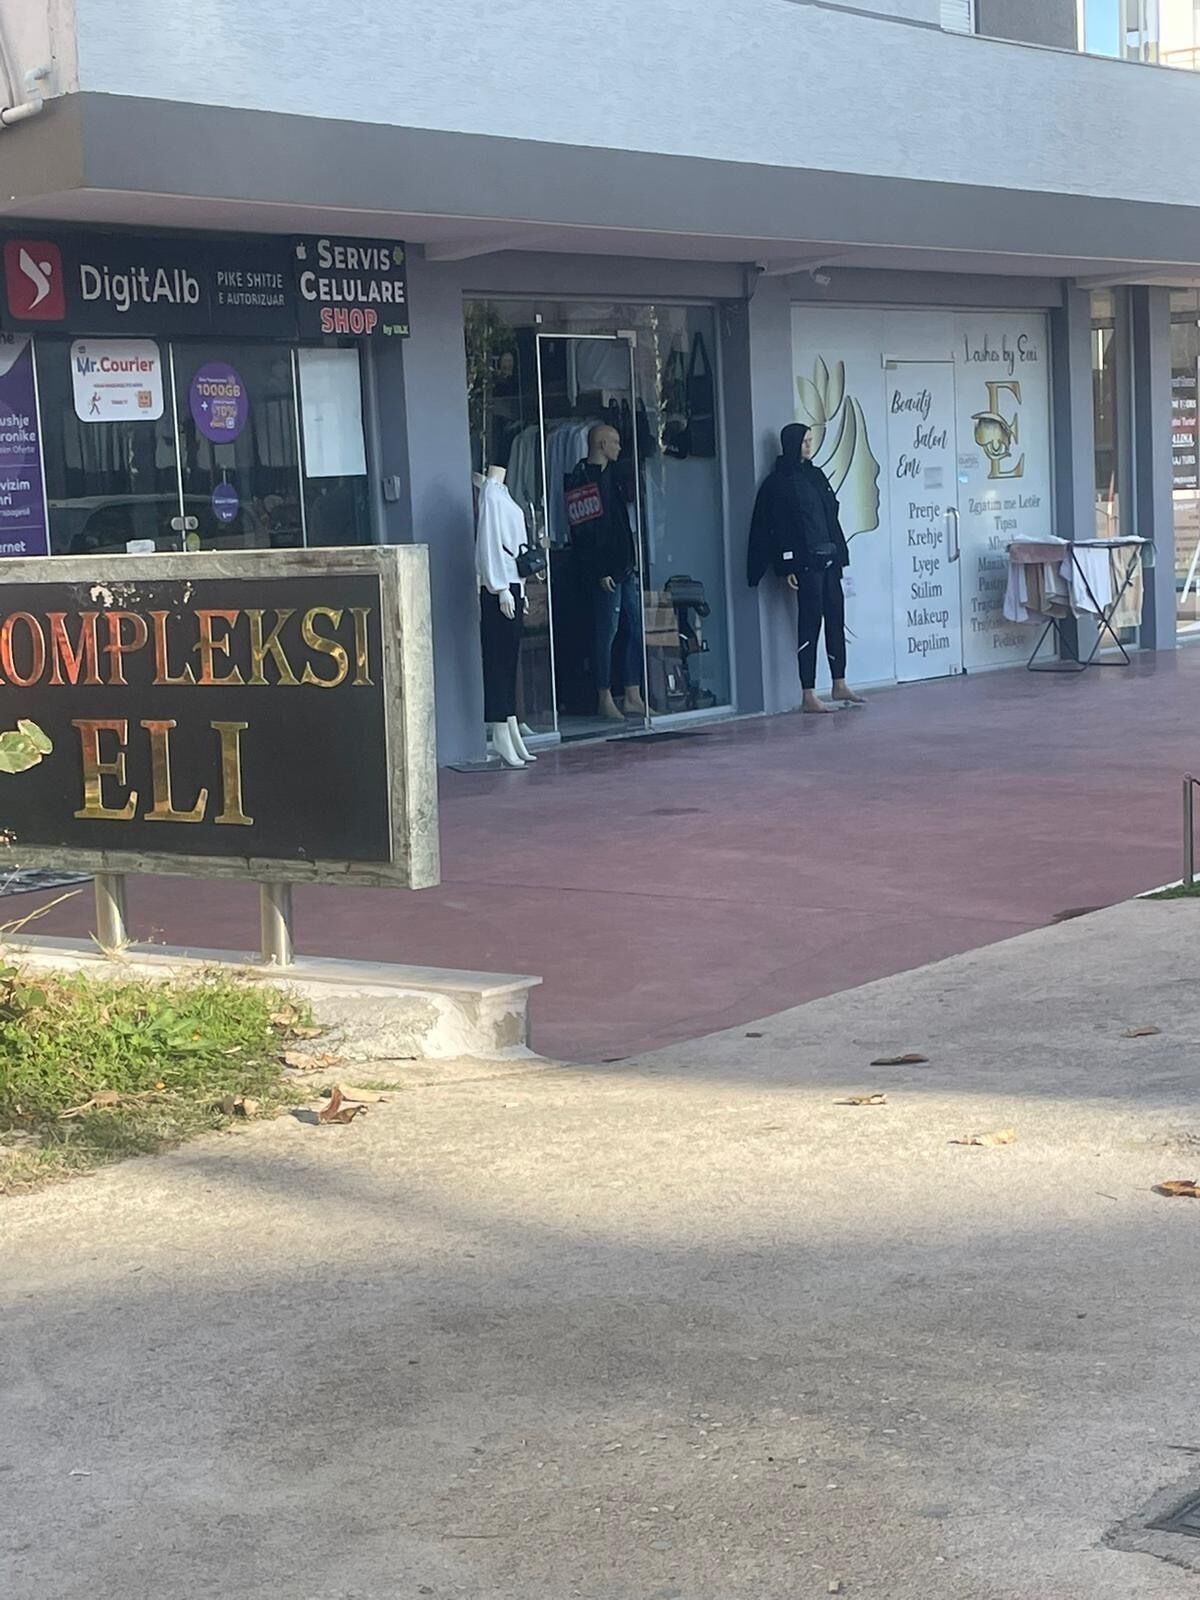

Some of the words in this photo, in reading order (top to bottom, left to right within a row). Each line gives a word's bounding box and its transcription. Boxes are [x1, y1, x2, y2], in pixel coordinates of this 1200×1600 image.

[317, 239, 391, 271] SERVIS
[80, 264, 200, 312] DigitAlb
[217, 271, 244, 287] PIKE
[247, 272, 284, 288] SHITJE
[300, 271, 405, 303] CELULARE
[227, 293, 285, 306] AUTORIZUAR
[320, 307, 378, 334] SHOP
[77, 356, 155, 376] Mr.Courier
[1003, 333, 1015, 376] by
[196, 383, 241, 397] 1000GB
[891, 389, 932, 421] Beauty
[913, 424, 948, 449] Salon
[896, 454, 922, 478] Emi
[909, 502, 941, 522] Prerje
[908, 528, 943, 549] Krehje
[913, 555, 940, 579] Lyeje
[911, 581, 943, 600] Stilim
[907, 608, 949, 628] Makeup
[0, 607, 374, 688] OMPLEKSI
[908, 633, 950, 657] Depilim
[71, 719, 254, 826] ELI
